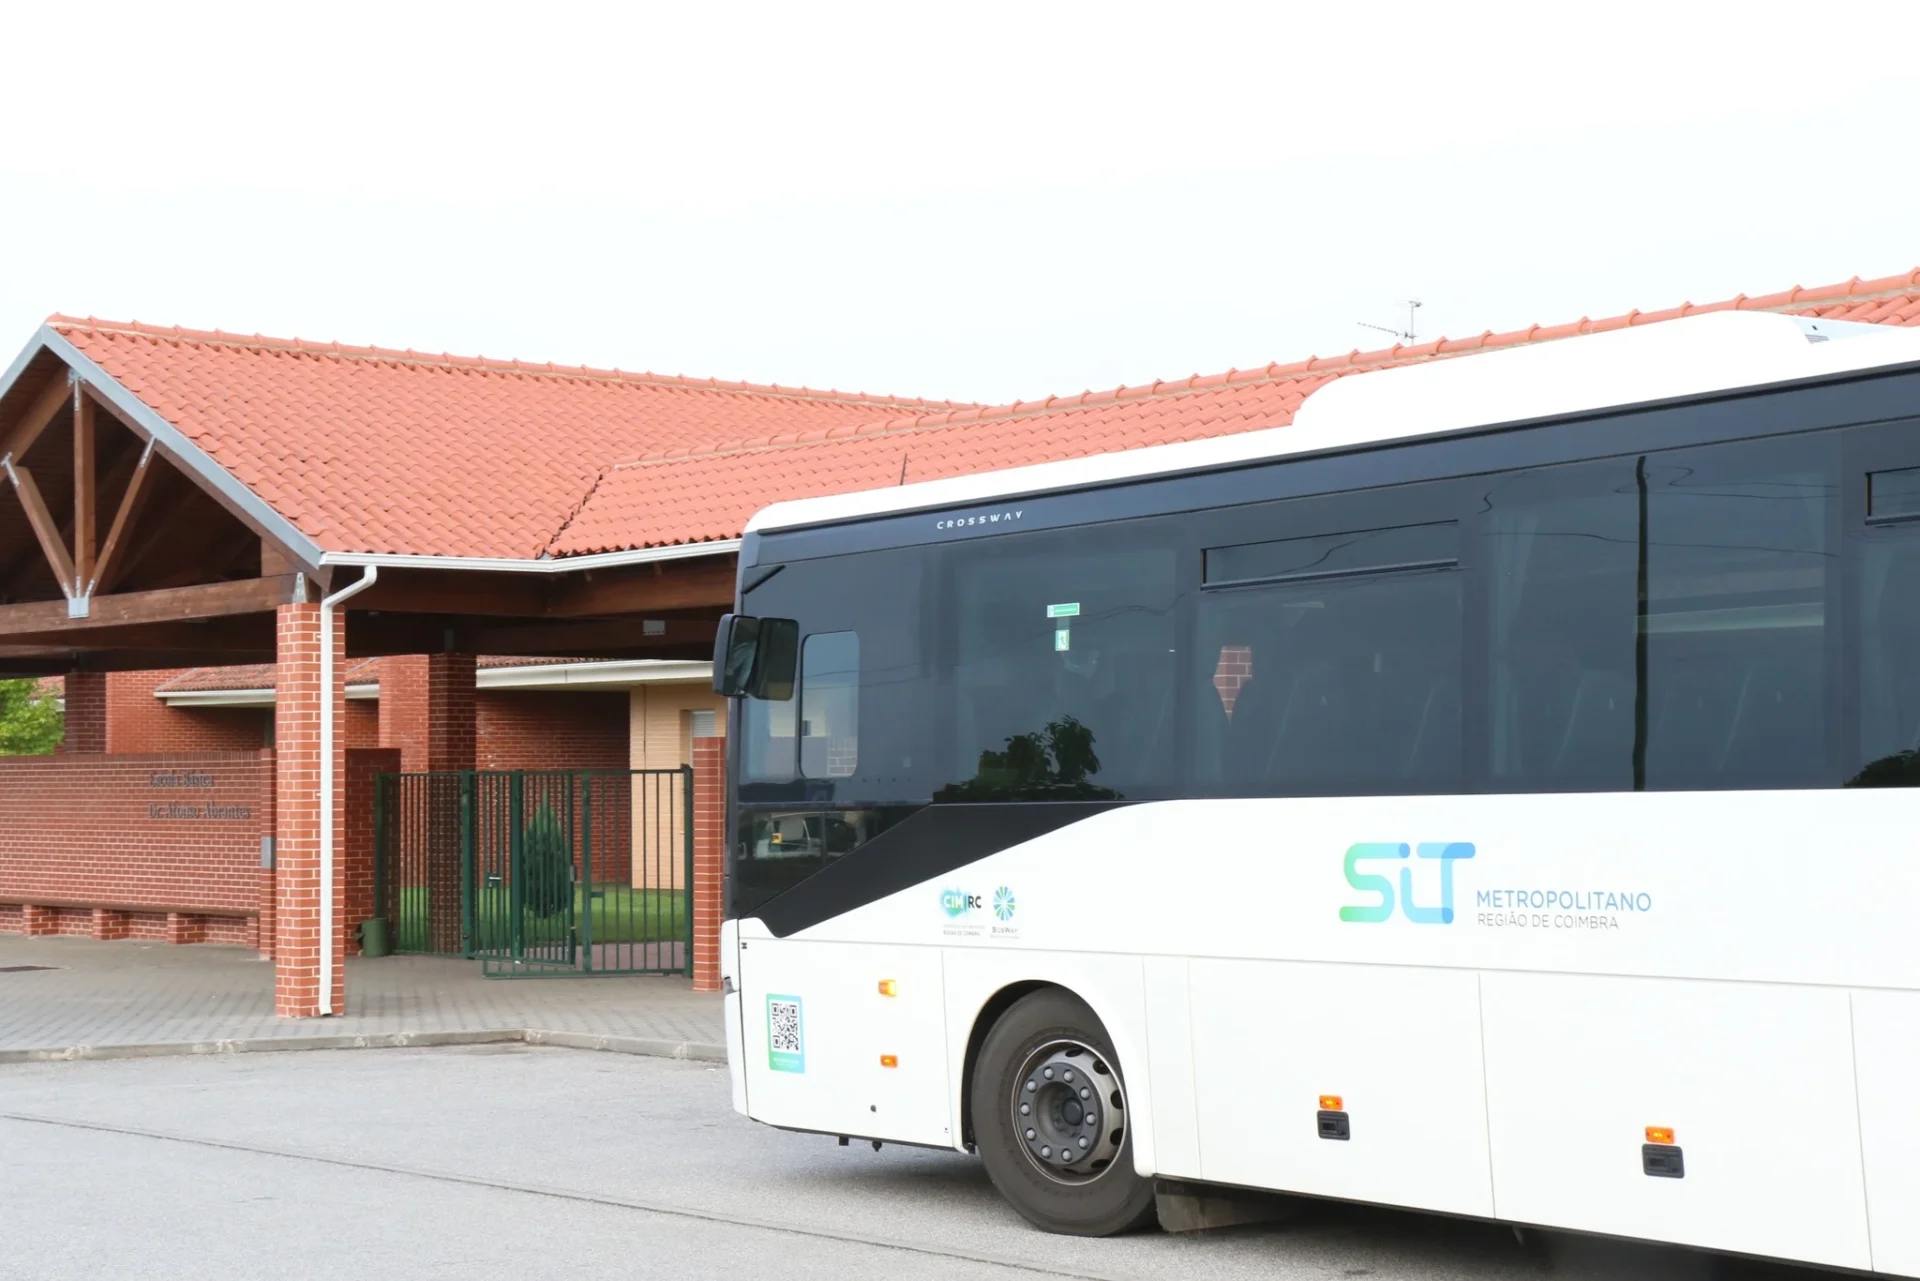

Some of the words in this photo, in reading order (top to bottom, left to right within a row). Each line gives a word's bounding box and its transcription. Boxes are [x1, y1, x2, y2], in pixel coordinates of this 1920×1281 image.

[937, 511, 1022, 529] CROSSWAY
[1476, 890, 1651, 911] METROPOLITANO
[1477, 912, 1526, 927] REGIÃO
[1531, 914, 1550, 927] DE
[1554, 915, 1619, 929] COIMBRA
